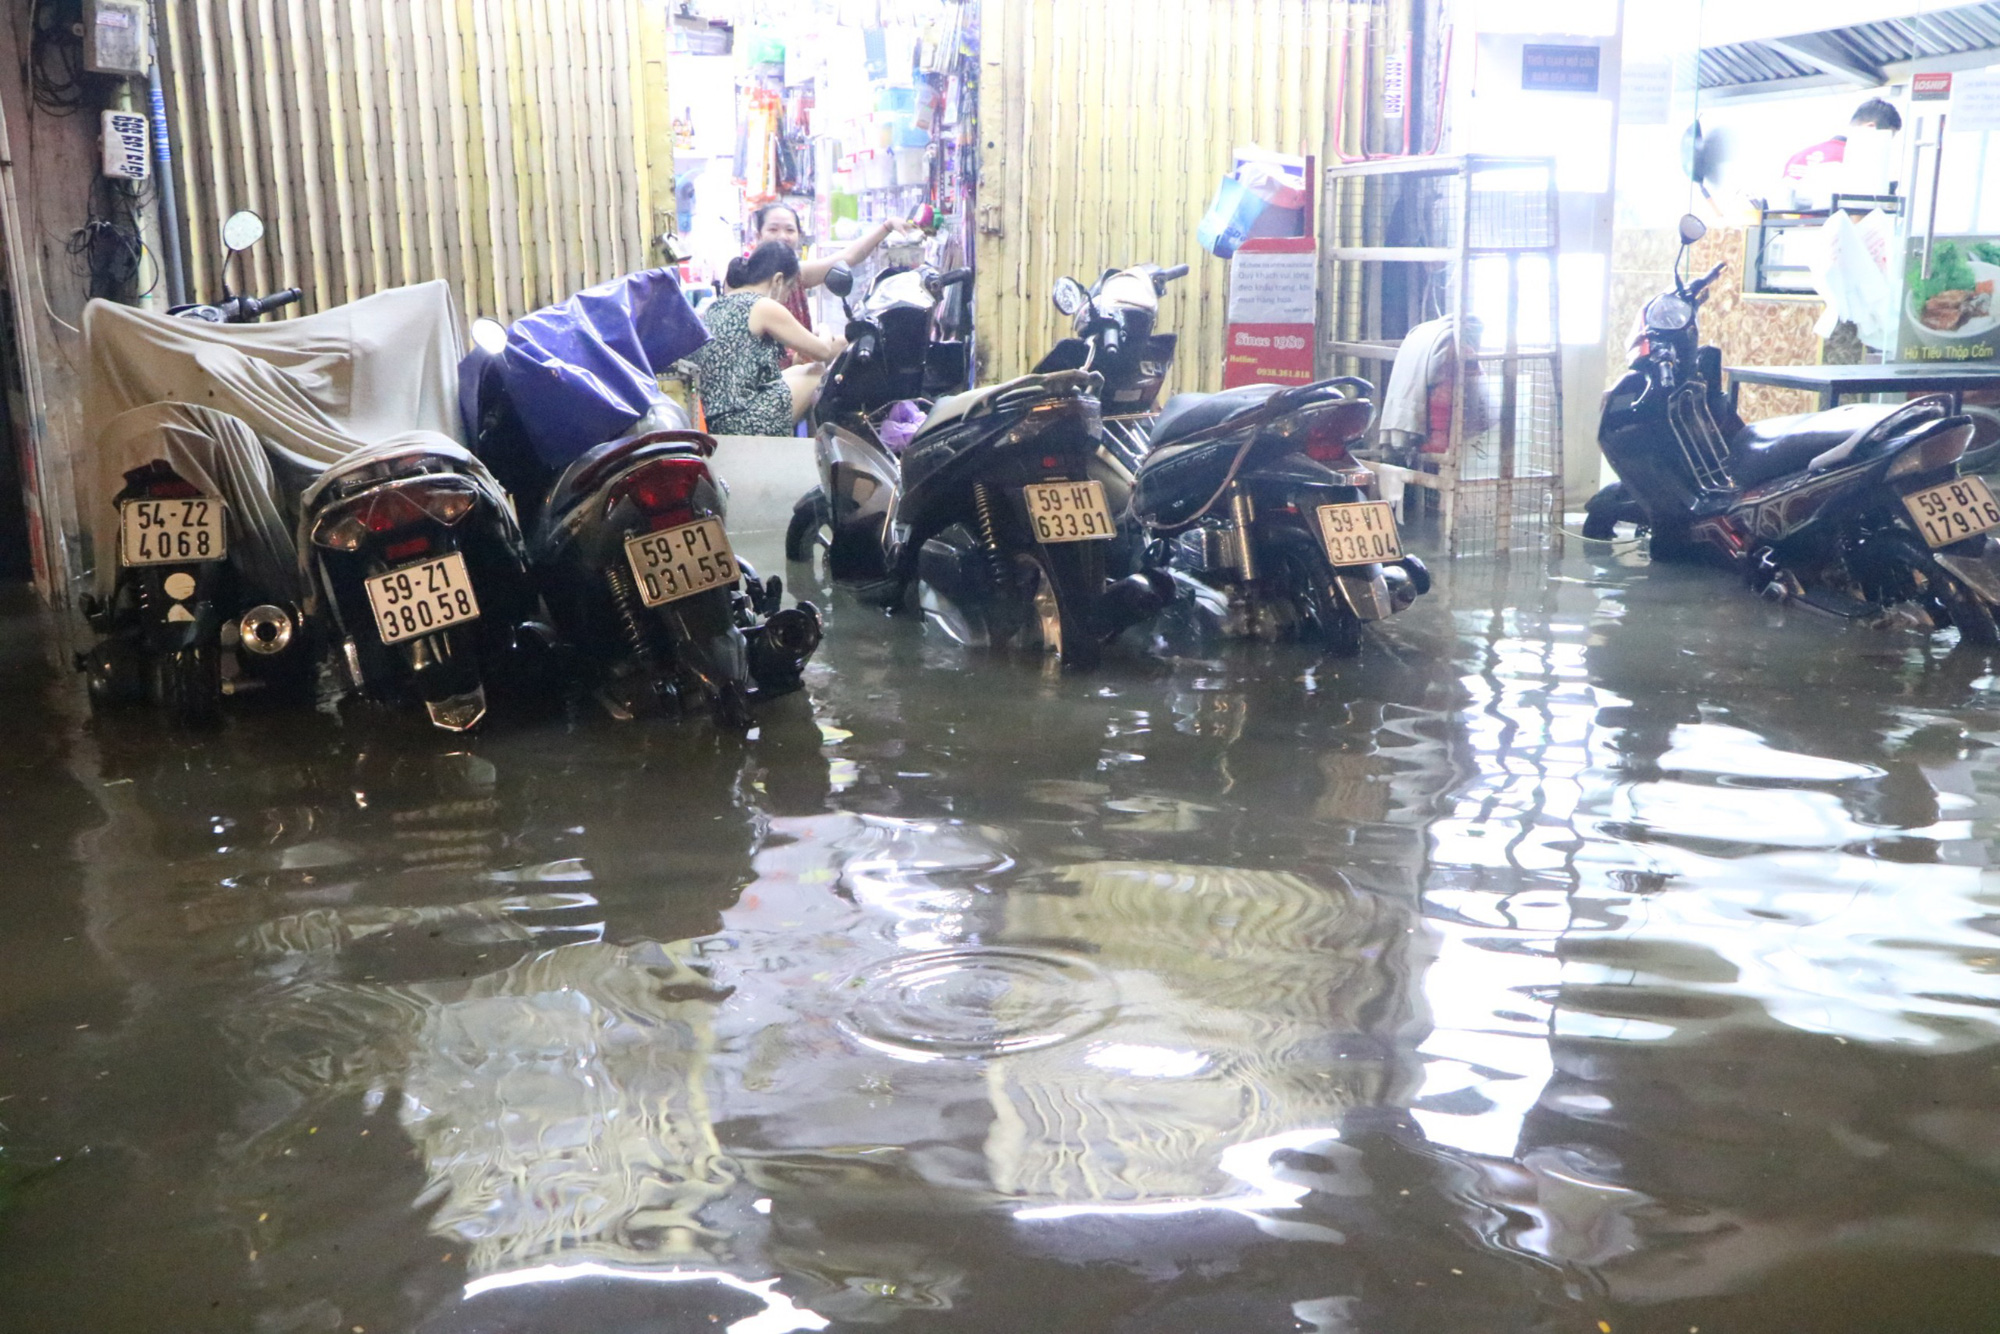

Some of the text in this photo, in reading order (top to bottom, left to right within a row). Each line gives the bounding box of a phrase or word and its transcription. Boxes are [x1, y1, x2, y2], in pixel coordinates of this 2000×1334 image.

[1234, 332, 1271, 347] Since
[1945, 344, 1969, 360] Thập
[1971, 340, 1993, 358] Cẩm
[1037, 487, 1093, 512] 59-H1
[137, 501, 209, 529] 54-Z2
[1037, 511, 1108, 538] 633.91
[1329, 507, 1383, 532] 59-V1
[1925, 502, 2000, 542] 179.16
[139, 531, 210, 560] 4068
[641, 526, 711, 568] 59-P1
[1331, 533, 1397, 560] 338.04
[381, 561, 451, 604] 59-Z1
[644, 551, 732, 600] 031.55
[383, 588, 471, 637] 380.58
